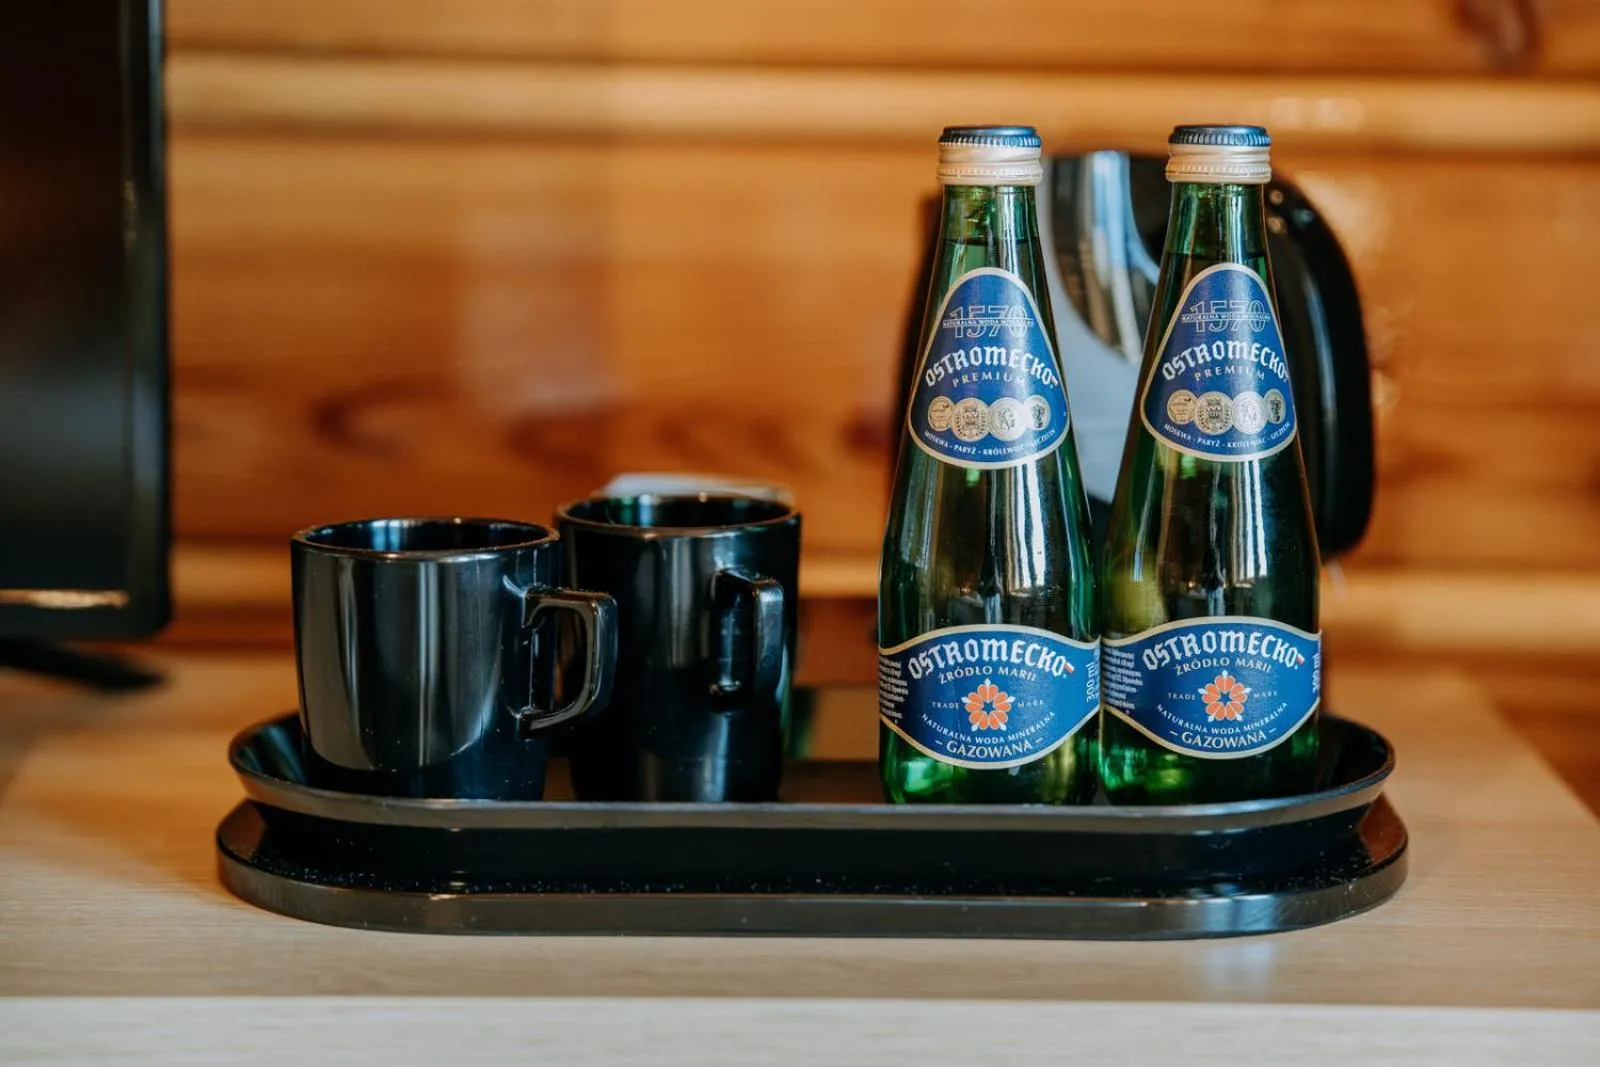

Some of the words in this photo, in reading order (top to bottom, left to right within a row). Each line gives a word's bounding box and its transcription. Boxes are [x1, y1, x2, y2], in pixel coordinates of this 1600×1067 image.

[950, 305, 1028, 338] 1570
[1190, 300, 1265, 333] 1570
[925, 346, 1053, 388] OSTROMECKO
[1162, 340, 1286, 381] OSTROMECKO
[1195, 365, 1265, 382] PREMIUM
[952, 371, 1027, 388] PREMIUM
[907, 638, 1066, 680] OSTROMECKO
[1142, 630, 1297, 671] OSTROMECKO
[1235, 657, 1272, 673] MARII
[998, 666, 1037, 682] MARII
[921, 713, 972, 743] NATURALNA
[975, 736, 1004, 745] WODA
[1007, 711, 1056, 742] MINERALNA
[1156, 704, 1208, 734] NATURALNA
[1211, 727, 1240, 735] WODA
[1243, 702, 1288, 732] MINERALNA
[946, 739, 1033, 759] GAZOWANA
[1182, 730, 1267, 749] GAZOWANA
